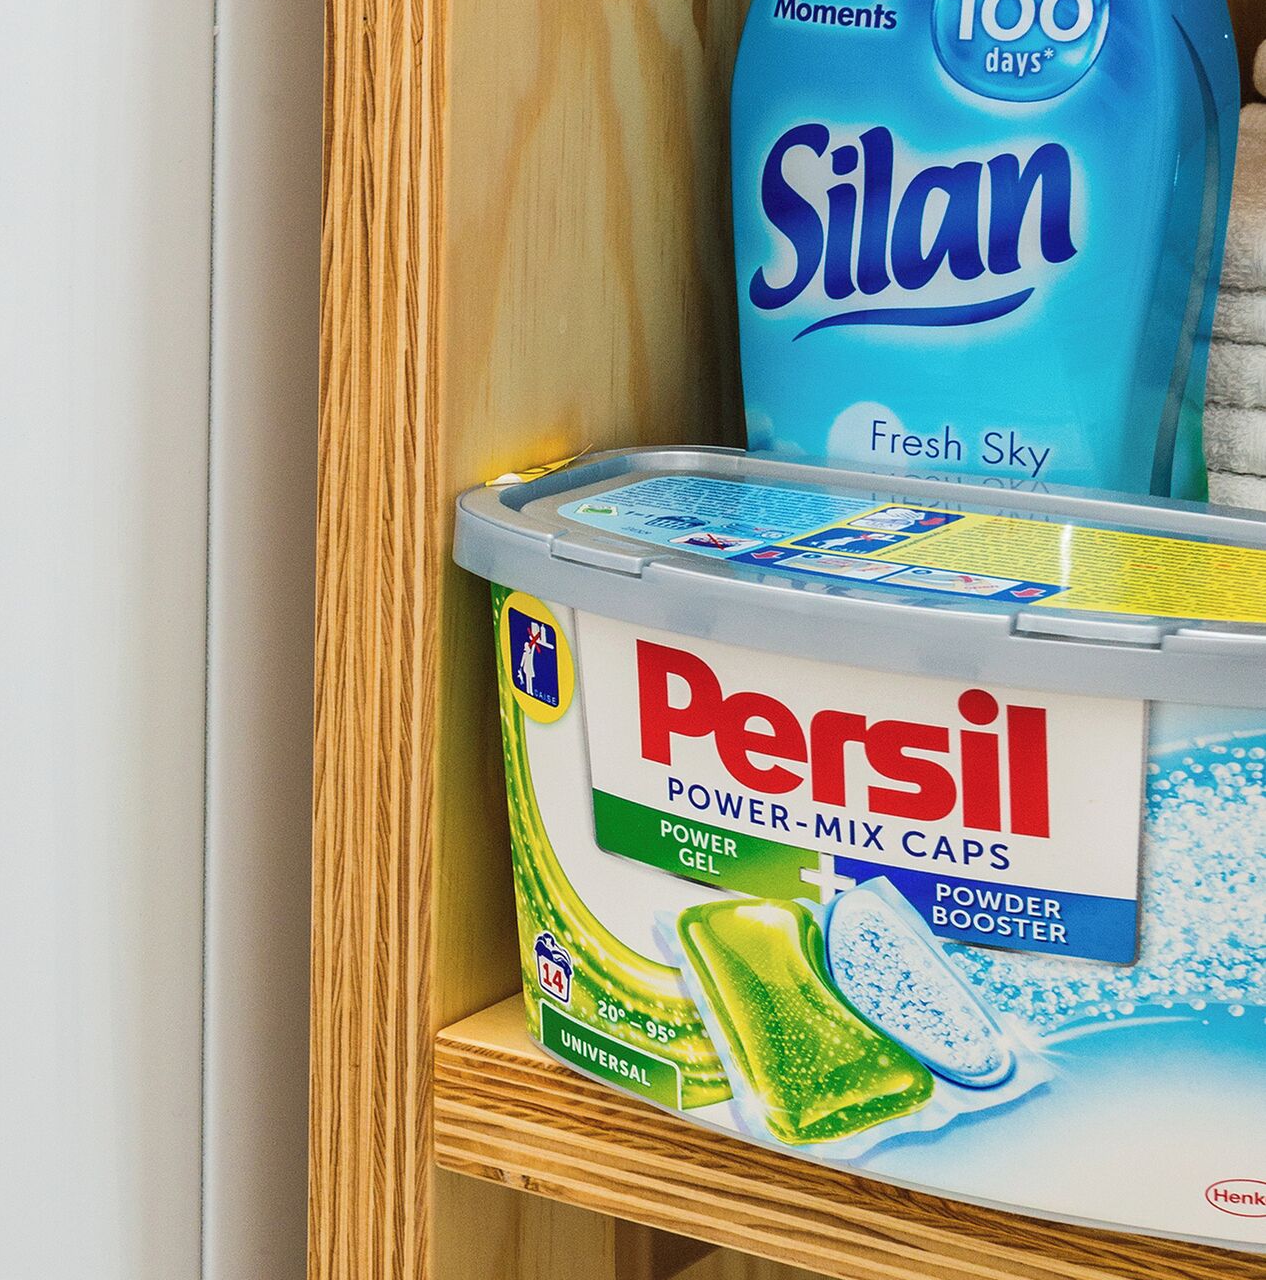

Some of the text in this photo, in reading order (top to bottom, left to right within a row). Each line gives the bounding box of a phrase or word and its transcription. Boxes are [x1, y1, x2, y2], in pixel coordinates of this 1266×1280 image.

[749, 122, 1078, 311] Silan
[870, 419, 1051, 478] Fresh Sky
[635, 636, 1051, 840] Persil
[660, 819, 738, 859] POWER
[667, 776, 1010, 871] POWER-MIX CAPS
[679, 848, 720, 876] GEL
[936, 883, 1062, 919] POWDER
[932, 905, 1067, 944] BOOSTER
[542, 962, 564, 994] 14
[597, 999, 626, 1023] 20°
[645, 1020, 676, 1044] 95°
[560, 1029, 651, 1087] UNIVERSAL
[1214, 1188, 1266, 1206] Henk
